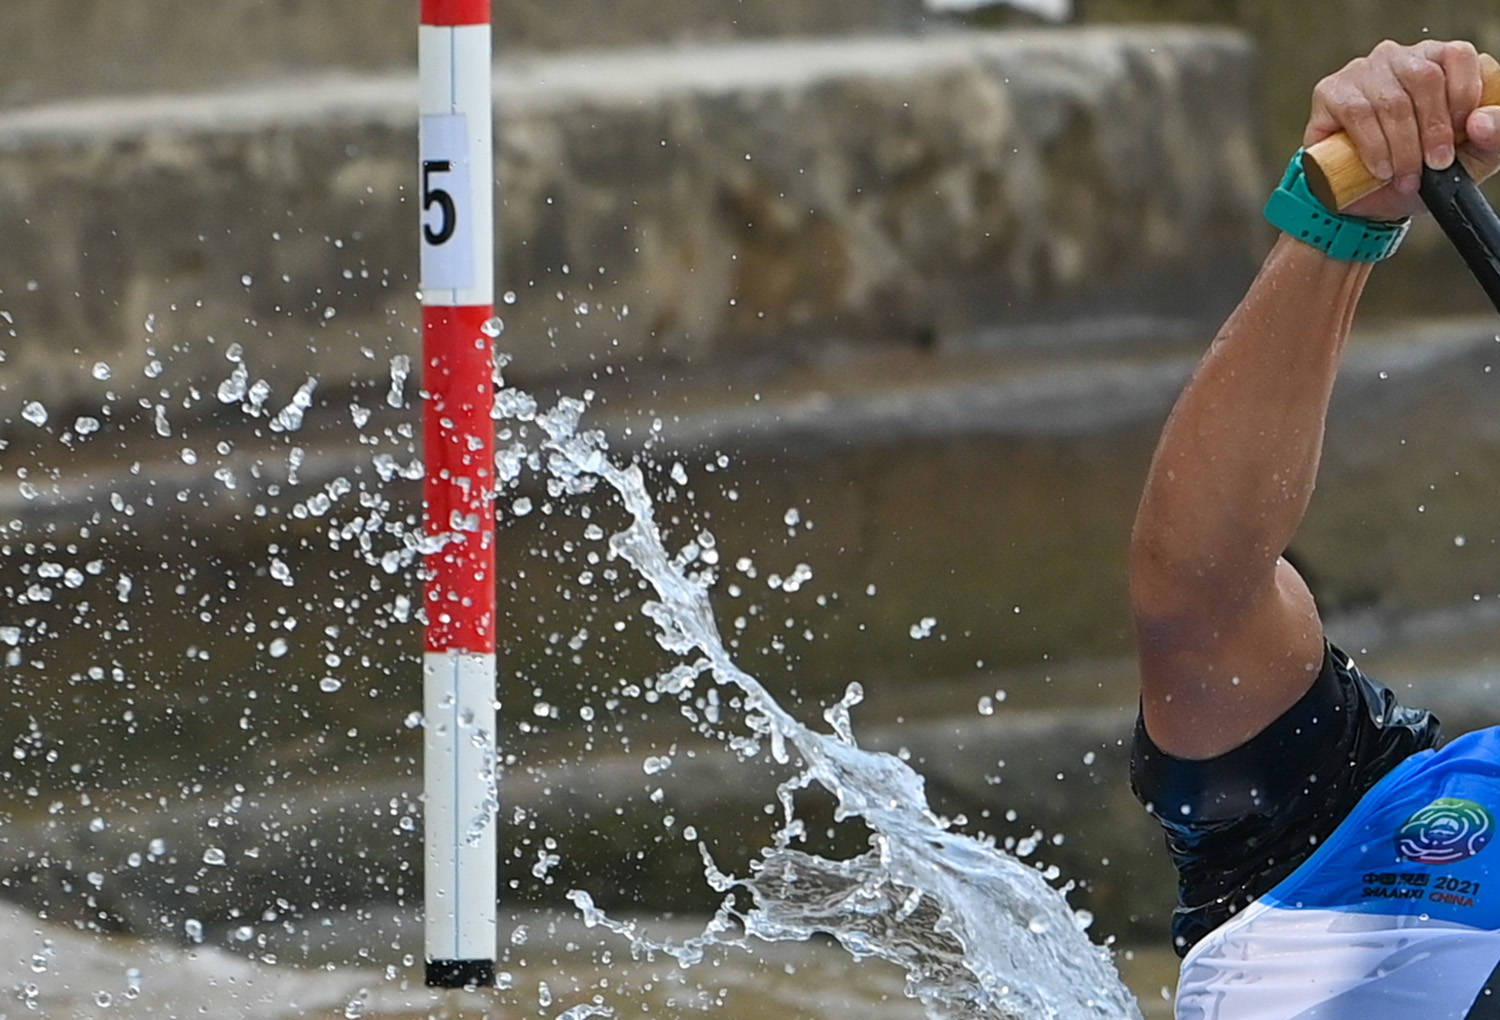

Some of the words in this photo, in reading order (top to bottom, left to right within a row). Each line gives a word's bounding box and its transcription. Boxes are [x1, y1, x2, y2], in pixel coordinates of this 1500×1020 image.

[423, 160, 456, 246] 5
[1434, 876, 1480, 895] 2021
[1362, 888, 1424, 899] SHAANXI
[1429, 891, 1474, 906] CHINA
